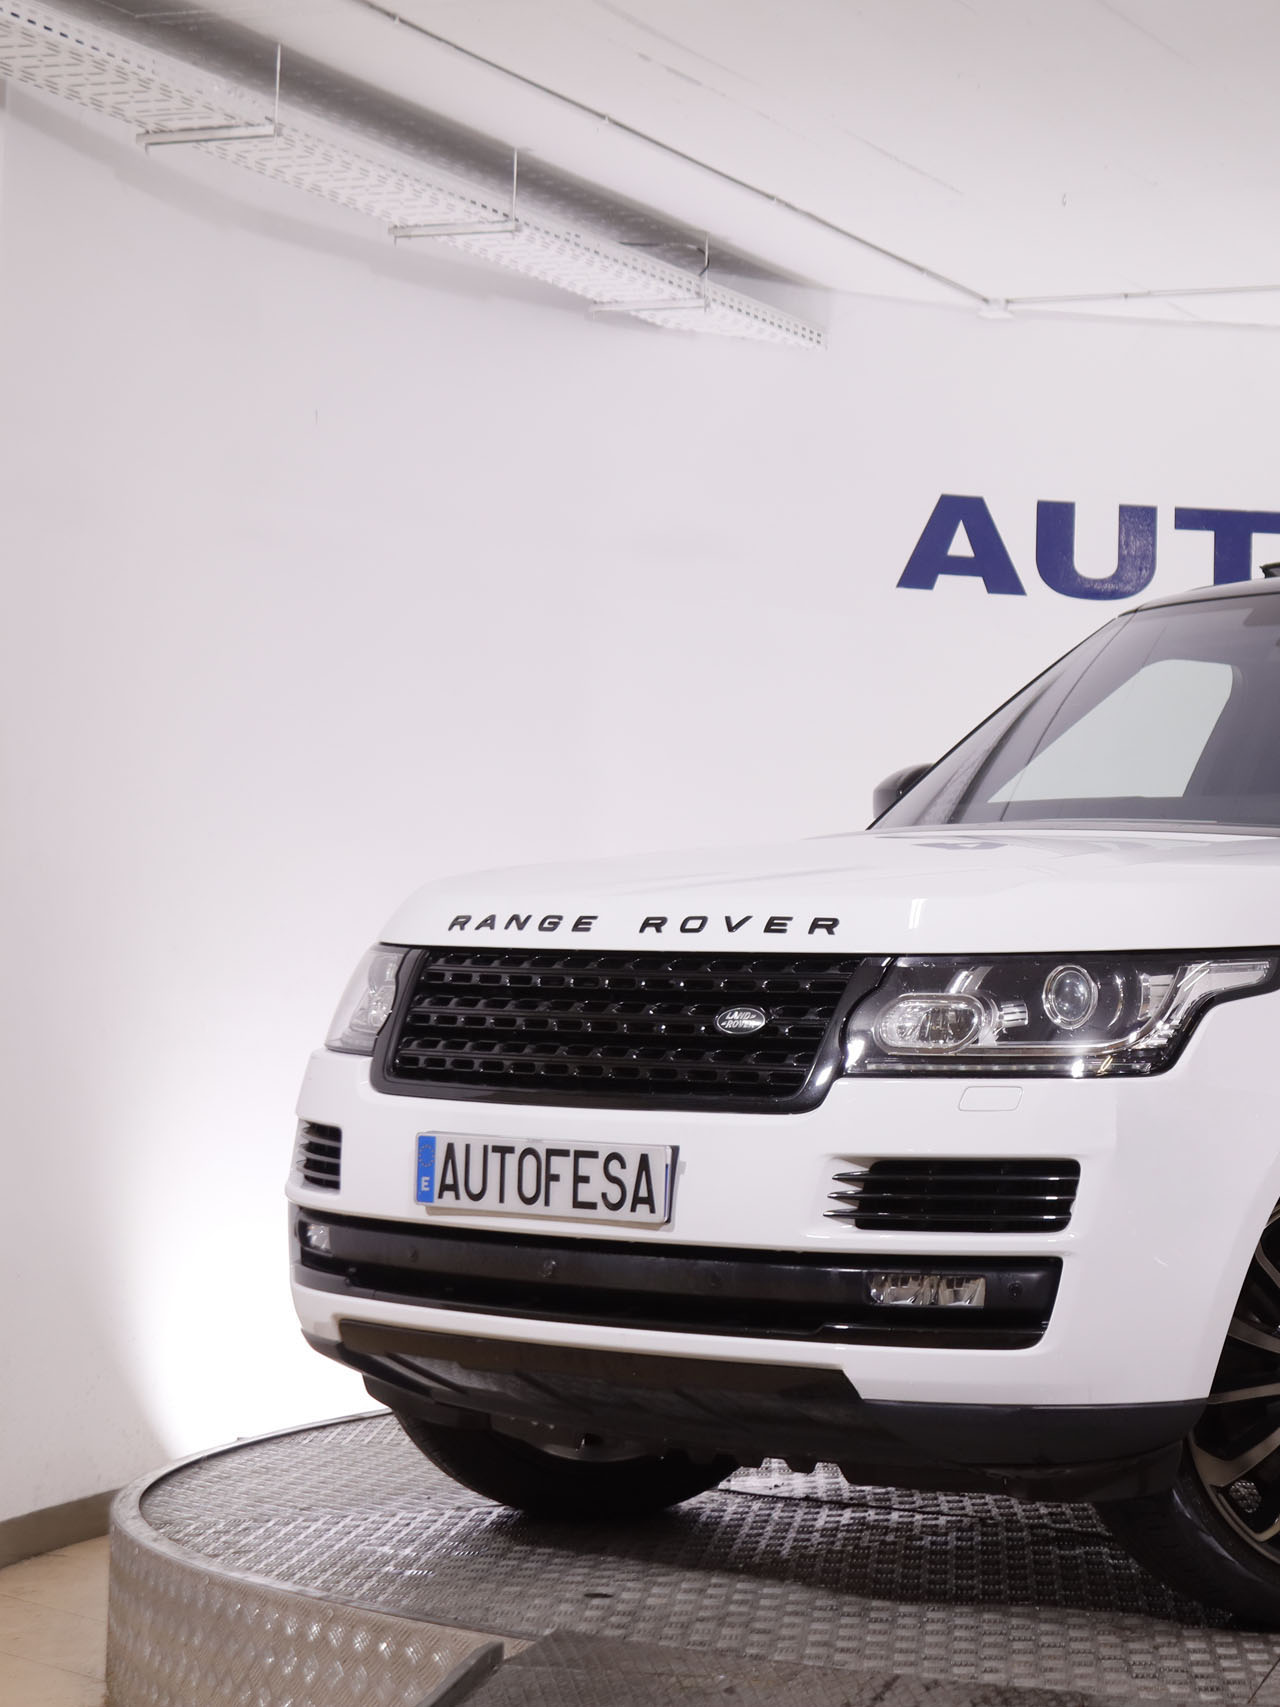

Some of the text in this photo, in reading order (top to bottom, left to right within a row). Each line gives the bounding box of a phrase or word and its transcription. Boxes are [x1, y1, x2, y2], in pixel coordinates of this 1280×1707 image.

[447, 913, 841, 935] RANGE ROVER
[725, 1011, 751, 1020] LAND
[420, 1176, 430, 1192] E
[437, 1142, 656, 1214] AUTOFESA
